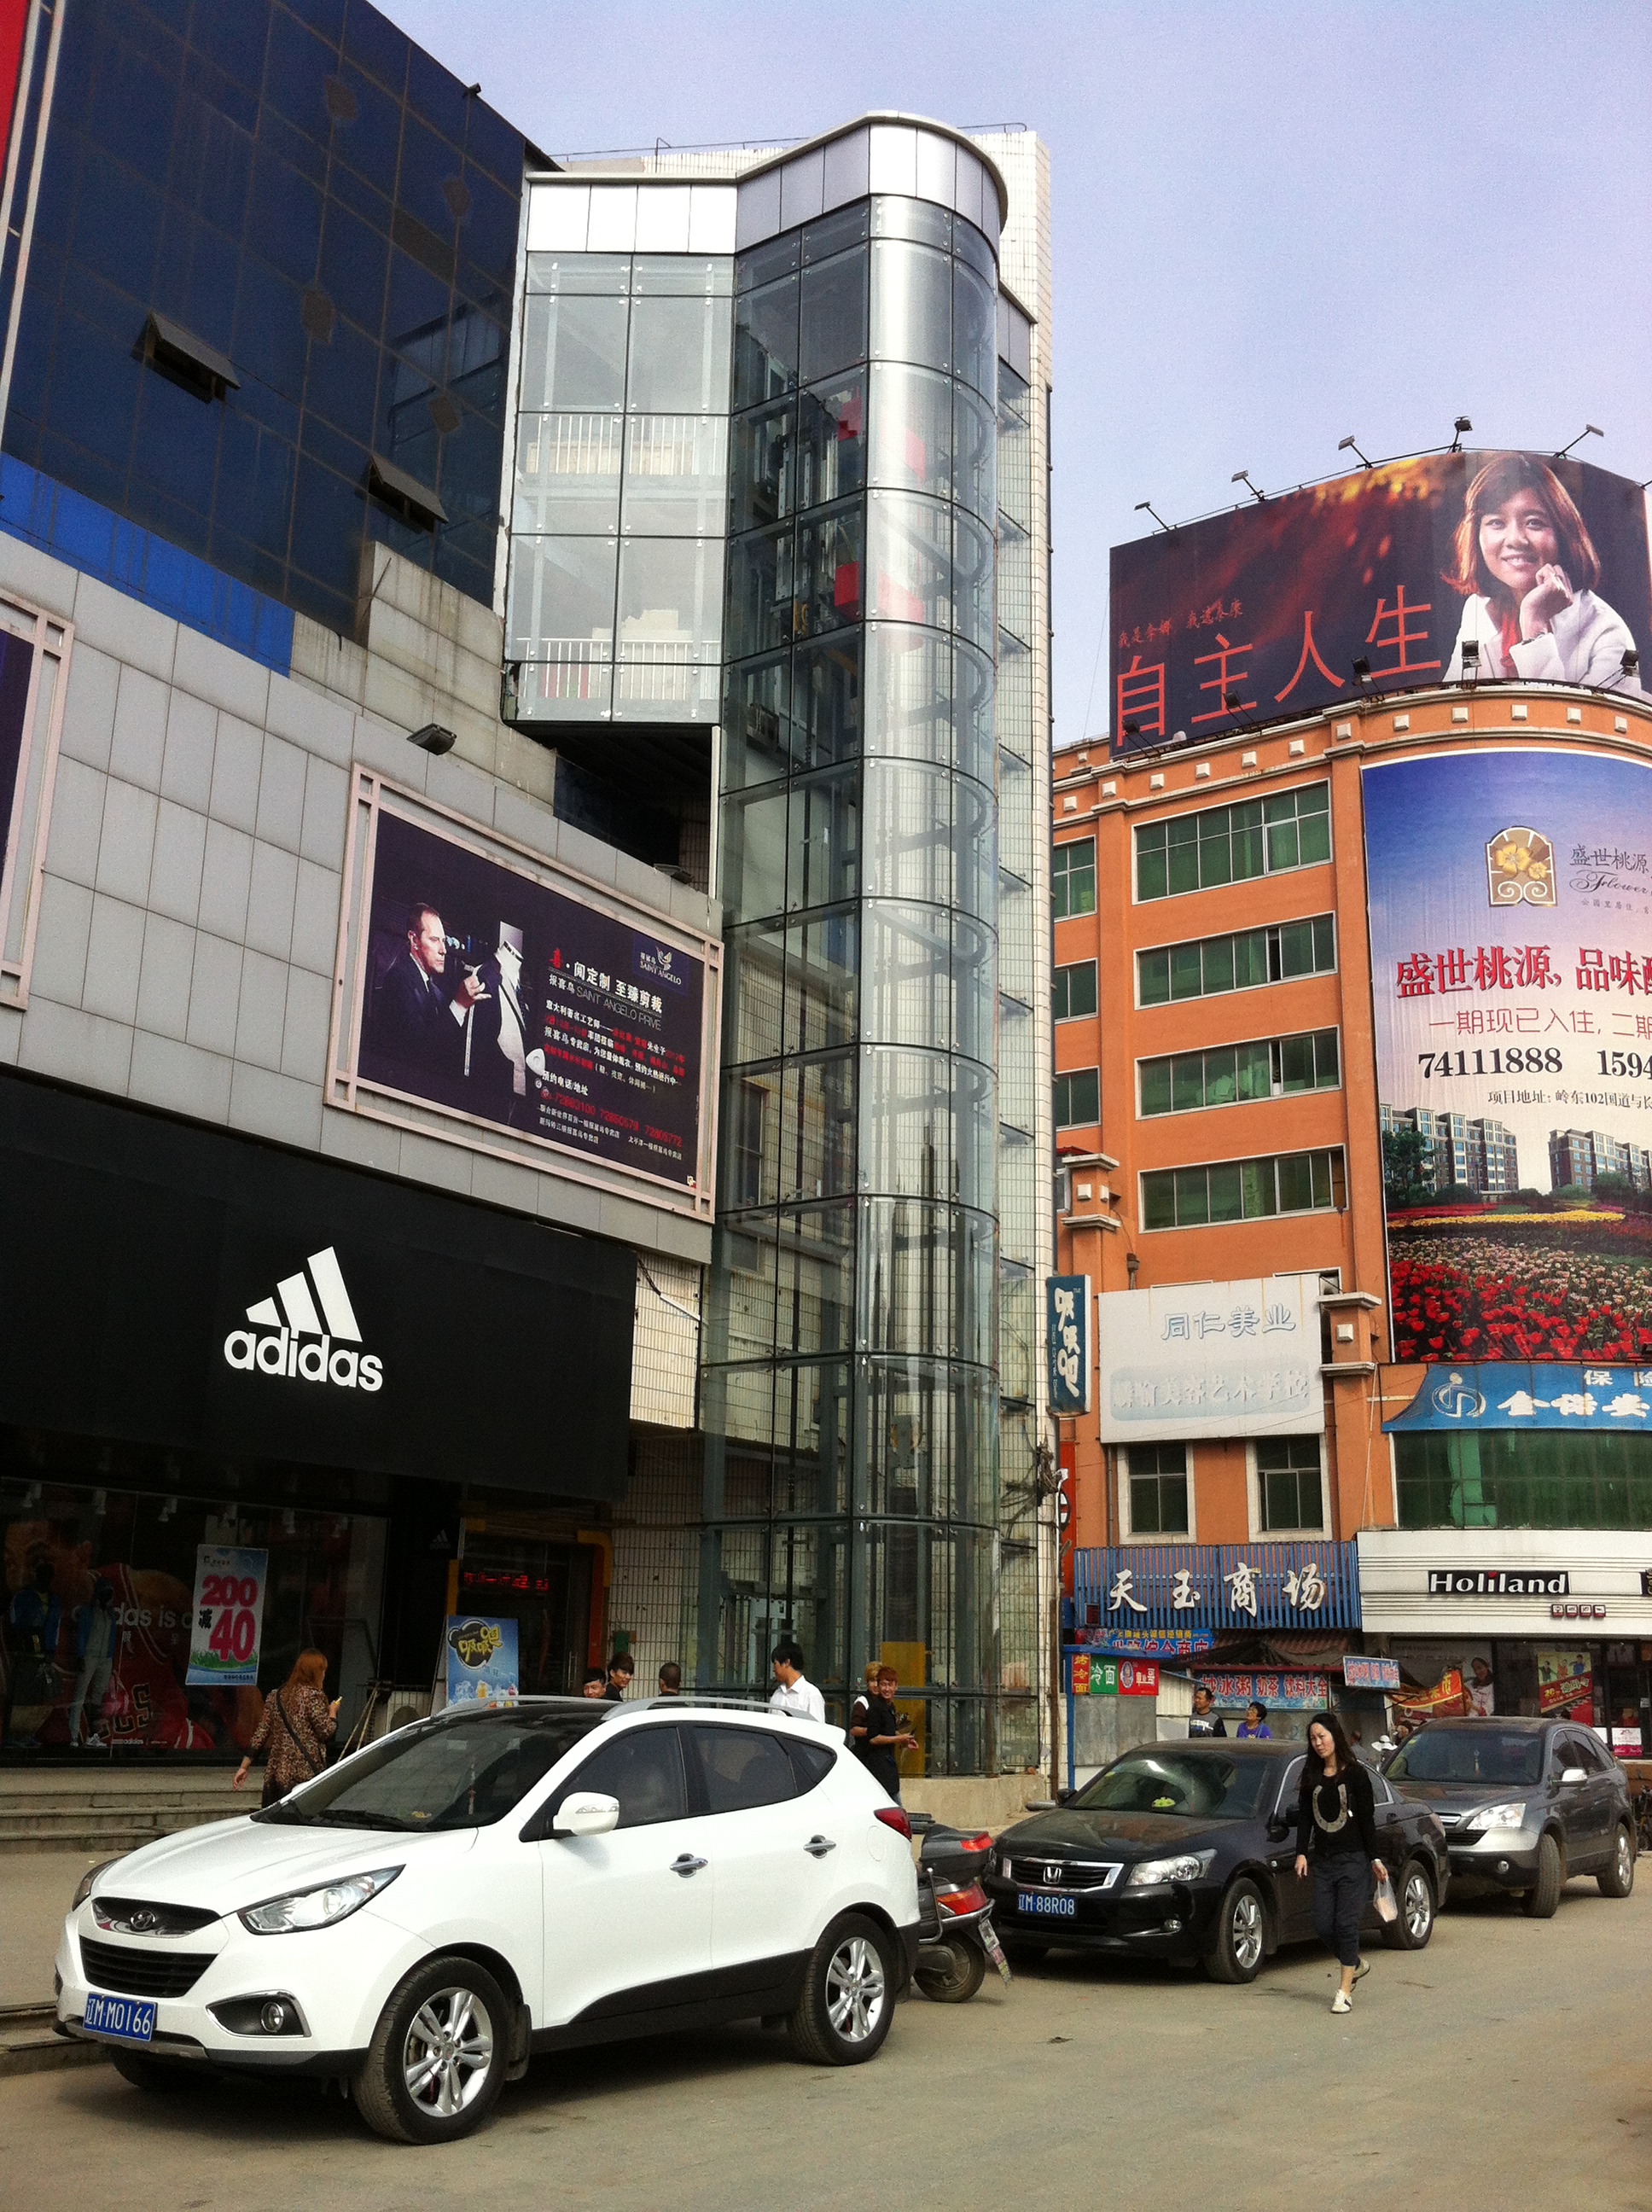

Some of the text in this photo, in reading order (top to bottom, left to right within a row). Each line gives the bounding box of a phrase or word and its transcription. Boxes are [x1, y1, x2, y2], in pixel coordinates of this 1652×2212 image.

[1115, 585, 1441, 747] 自主人生
[1570, 843, 1649, 874] 盛世桃源
[1417, 1048, 1563, 1079] 74111888
[1160, 1302, 1296, 1341] 同仁美业
[224, 1328, 384, 1392] adidas
[201, 1575, 259, 1608] 200
[1108, 1562, 1325, 1617] 天玉商场
[1429, 1571, 1566, 1594] Holiland
[209, 1609, 256, 1662] 40
